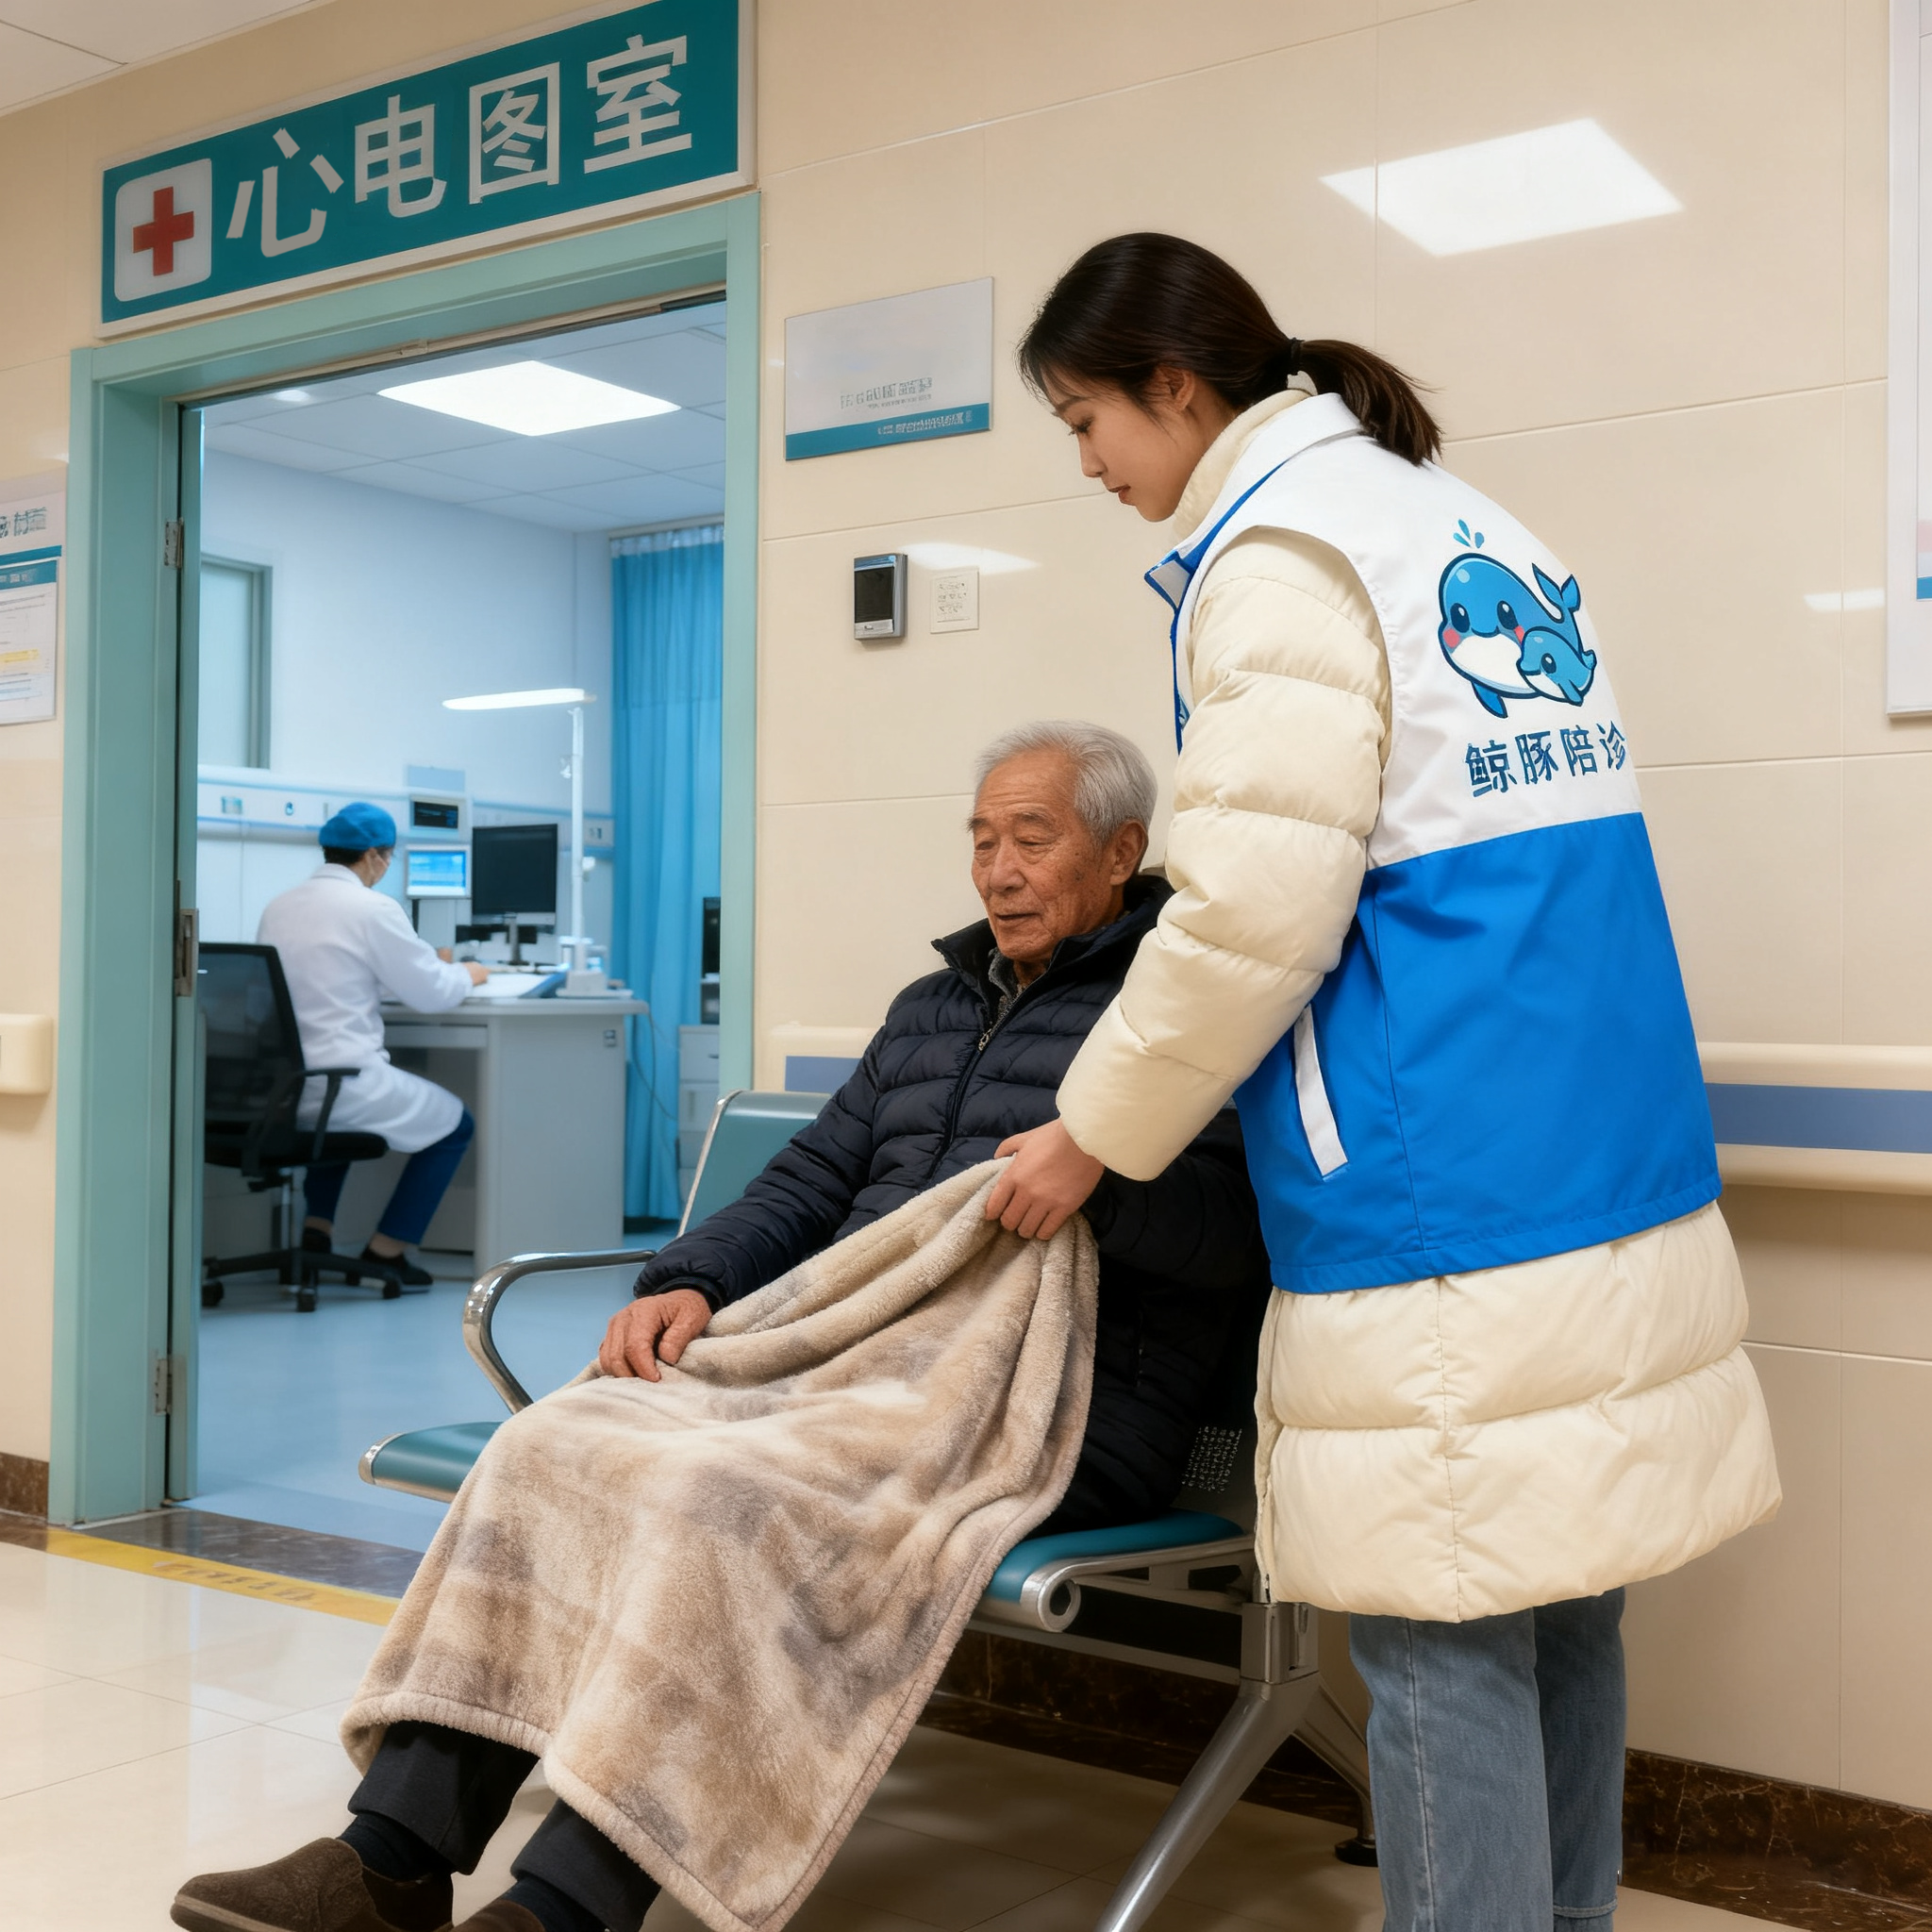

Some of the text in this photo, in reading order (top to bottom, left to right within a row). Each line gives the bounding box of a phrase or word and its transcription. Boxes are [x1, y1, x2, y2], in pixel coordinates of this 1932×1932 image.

[226, 34, 692, 258] 心电图室
[1465, 720, 1627, 798] 鲸豚陪诊
